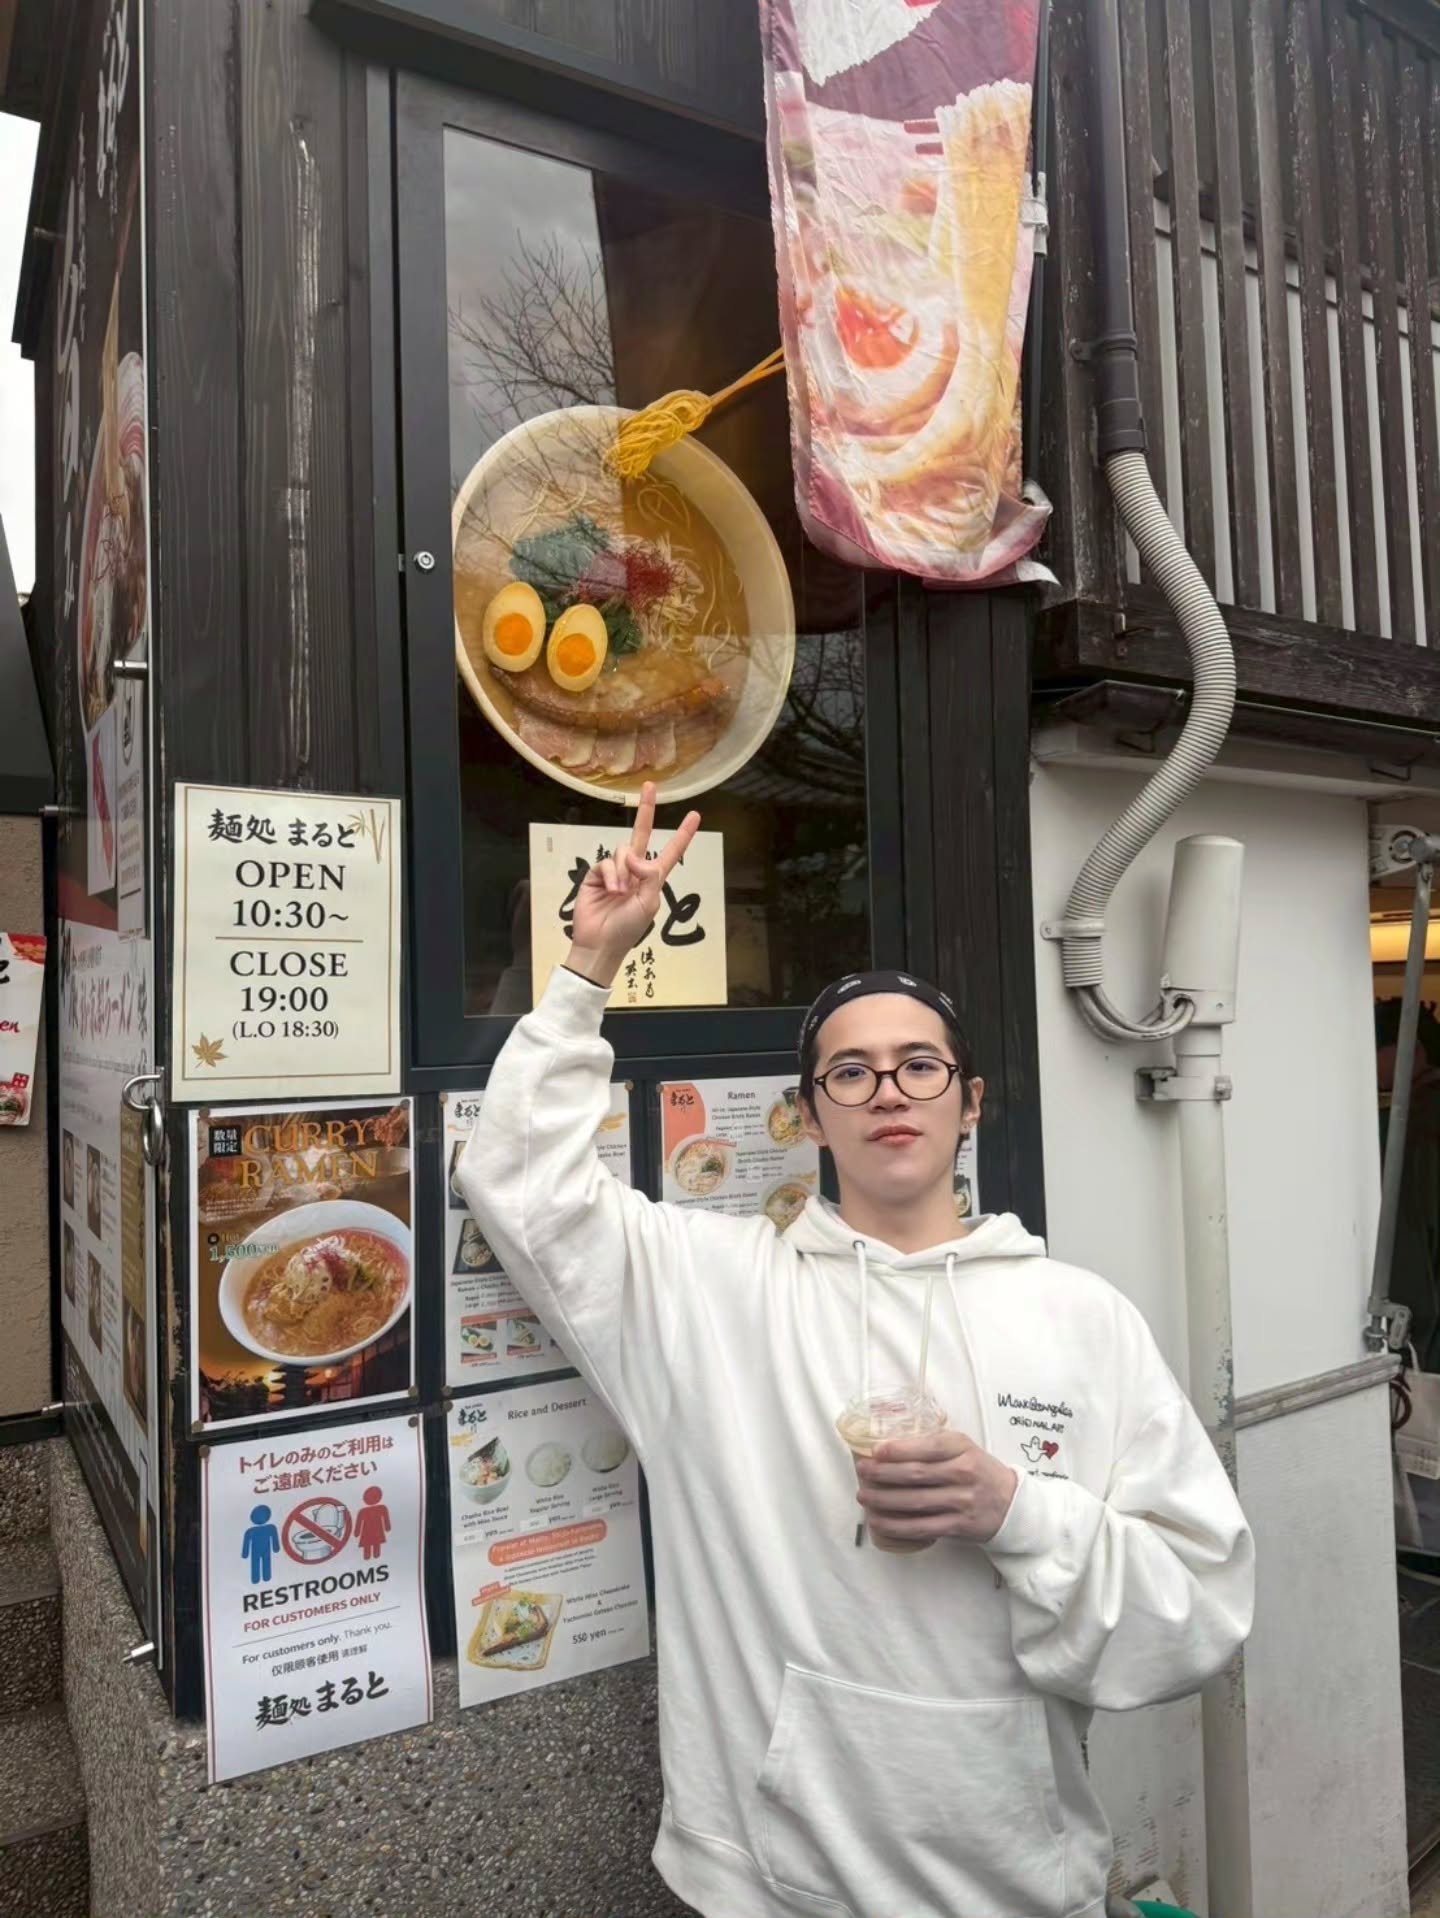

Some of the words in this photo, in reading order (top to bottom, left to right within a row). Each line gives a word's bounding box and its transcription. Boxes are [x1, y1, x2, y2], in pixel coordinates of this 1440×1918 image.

[208, 808, 277, 844] 麺処
[288, 817, 355, 848] まると
[235, 859, 346, 891] OPEN
[232, 899, 349, 929] 10:30~
[230, 950, 348, 977] CLOSE
[241, 986, 329, 1012] 19:00
[232, 1020, 276, 1040] (L.O
[282, 1020, 339, 1040] 18:30)
[727, 1091, 756, 1100] Ramen
[213, 1128, 238, 1141] 数量
[213, 1141, 238, 1154] 限定
[243, 1120, 373, 1153] CURRY
[240, 1150, 378, 1189] RAMEN
[507, 1410, 529, 1420] Rice
[531, 1404, 549, 1416] and
[551, 1398, 587, 1412] Dessert
[239, 1435, 395, 1474] トイレのみのご利用は
[253, 1460, 378, 1494] ご遠慮ください
[243, 1565, 389, 1613] RESTROOMS
[244, 1622, 270, 1633] FOR
[272, 1599, 347, 1626] CUSTOMERS
[350, 1592, 381, 1607] ONLY
[242, 1654, 259, 1665] For
[262, 1640, 316, 1660] customers
[318, 1633, 342, 1647] only.
[344, 1625, 372, 1640] Thank
[374, 1621, 392, 1635] you.
[590, 1628, 607, 1642] yen
[255, 1694, 312, 1731] 麺処
[316, 1670, 390, 1713] まると
